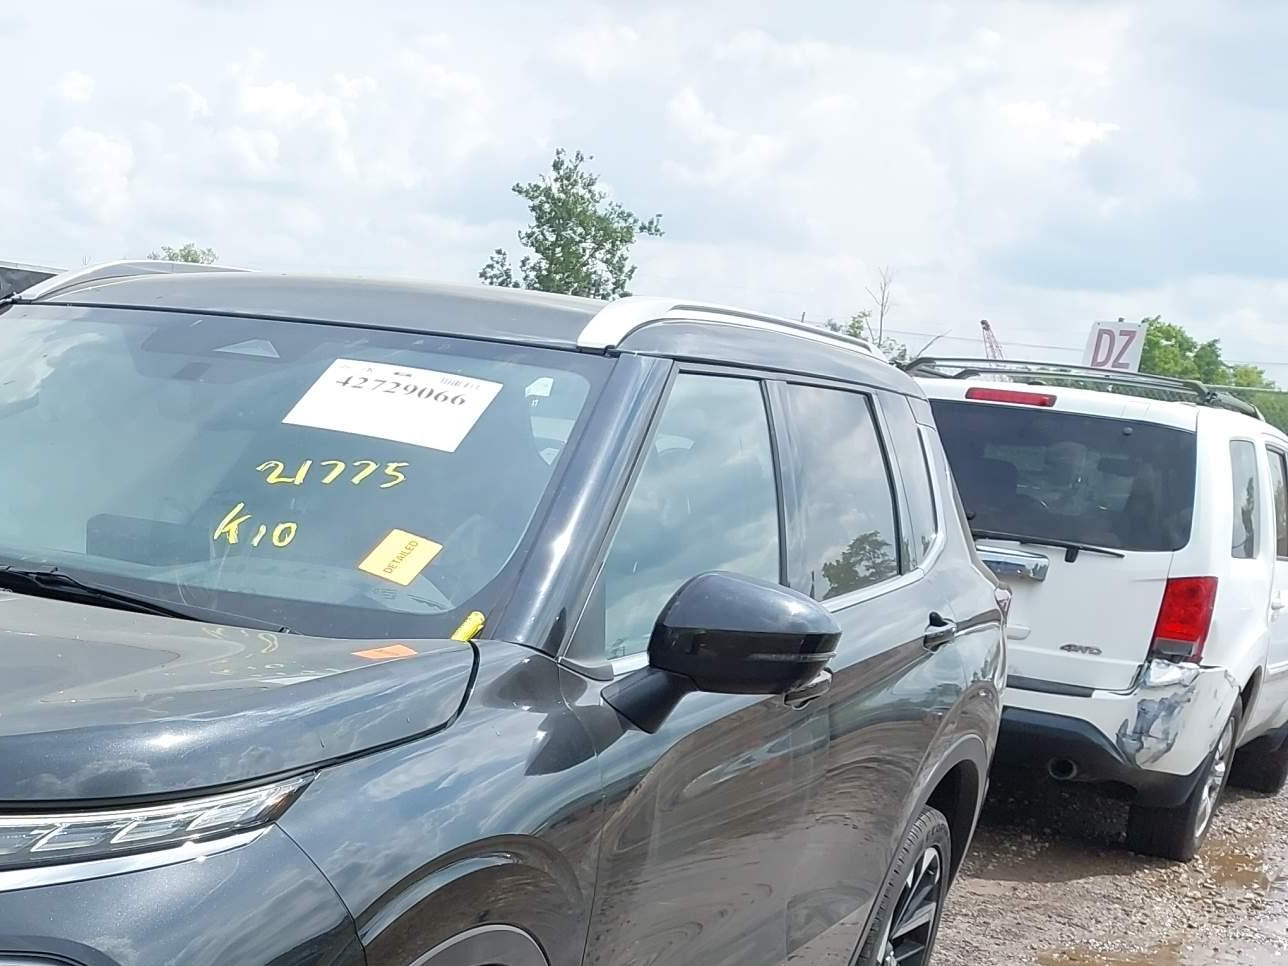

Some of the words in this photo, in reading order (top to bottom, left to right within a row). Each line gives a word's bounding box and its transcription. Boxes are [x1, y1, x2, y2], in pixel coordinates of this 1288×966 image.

[1091, 328, 1137, 369] DZ
[335, 375, 466, 406] 42729066
[255, 459, 410, 489] 21775
[383, 539, 419, 574] DETAILED
